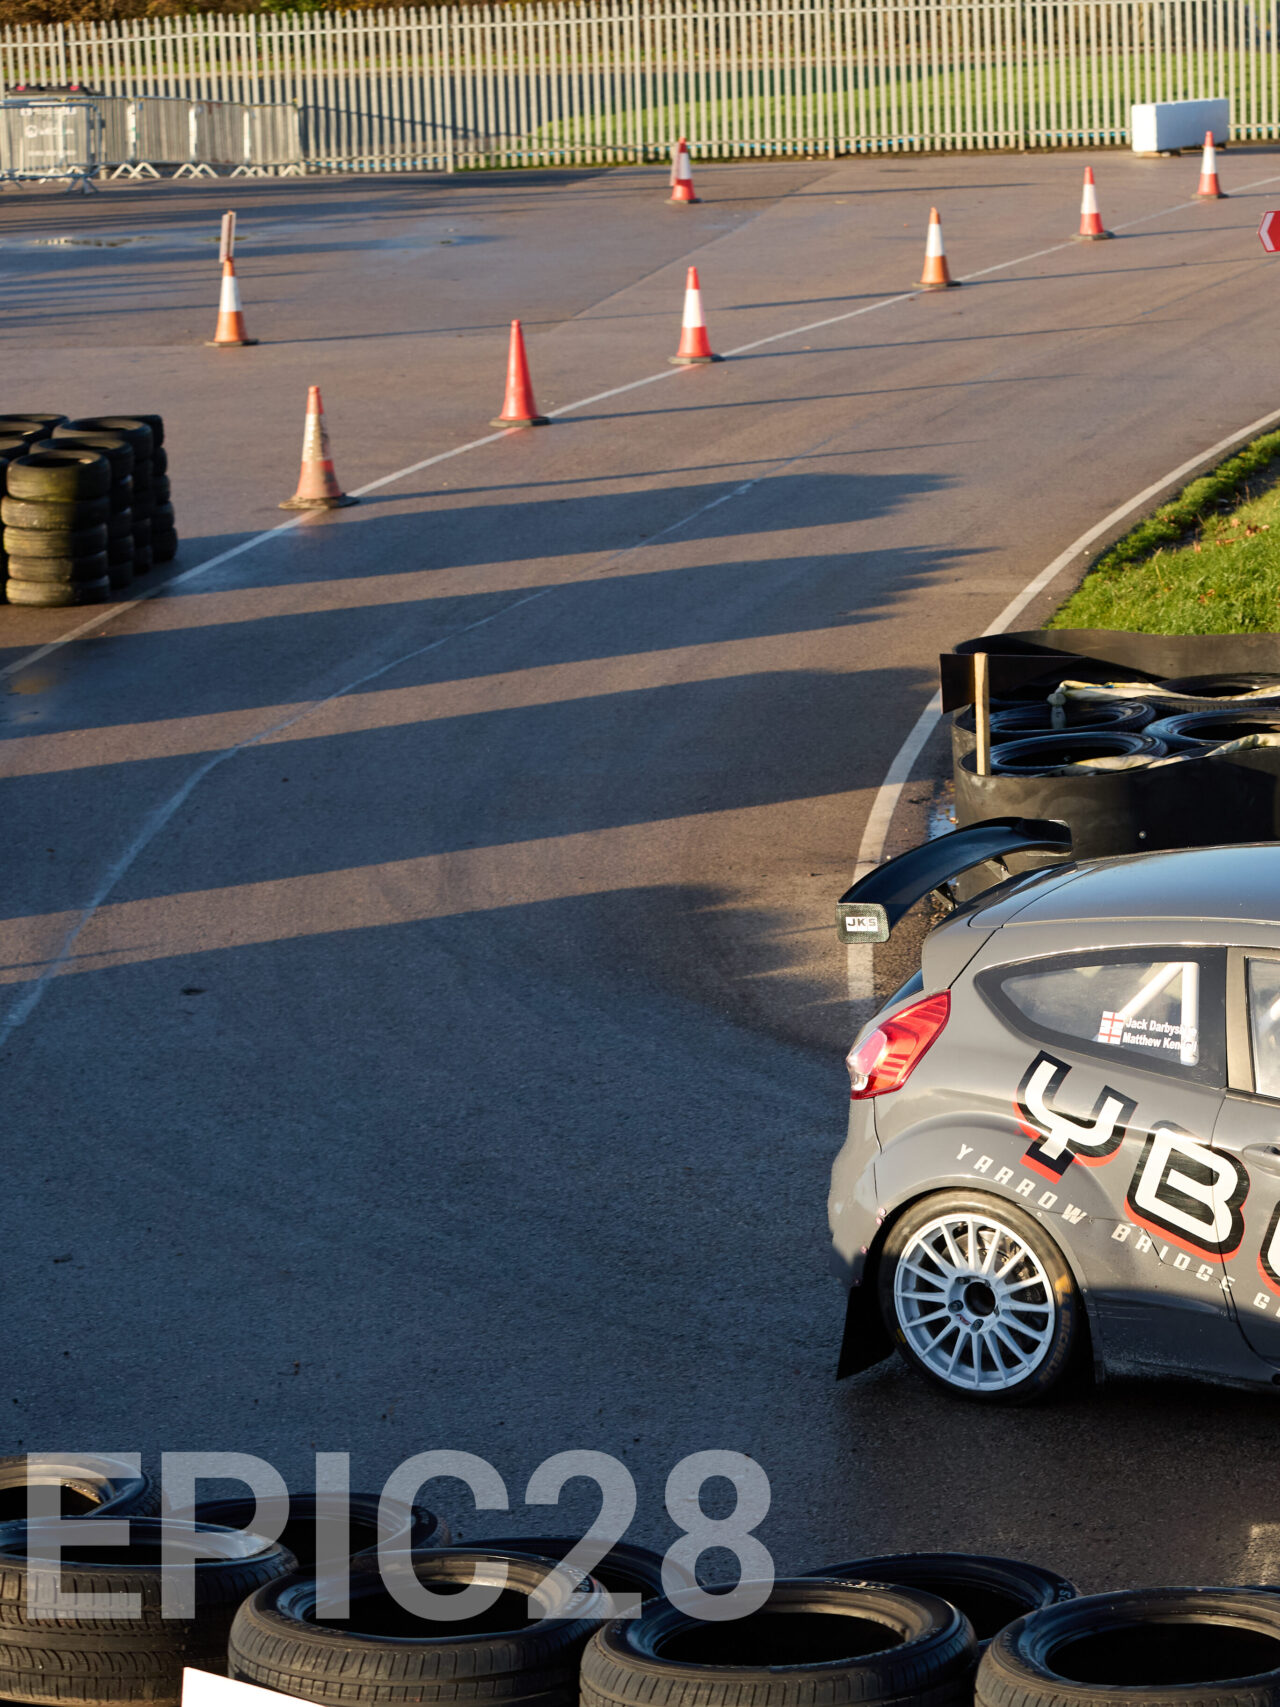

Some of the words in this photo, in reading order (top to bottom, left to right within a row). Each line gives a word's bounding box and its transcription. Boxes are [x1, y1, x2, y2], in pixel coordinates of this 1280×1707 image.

[847, 917, 877, 928] JKS
[1125, 1017, 1149, 1031] Jack
[1122, 1031, 1162, 1048] Matthew
[956, 1143, 1086, 1225] YARROW
[1111, 1227, 1236, 1293] BRIDGE
